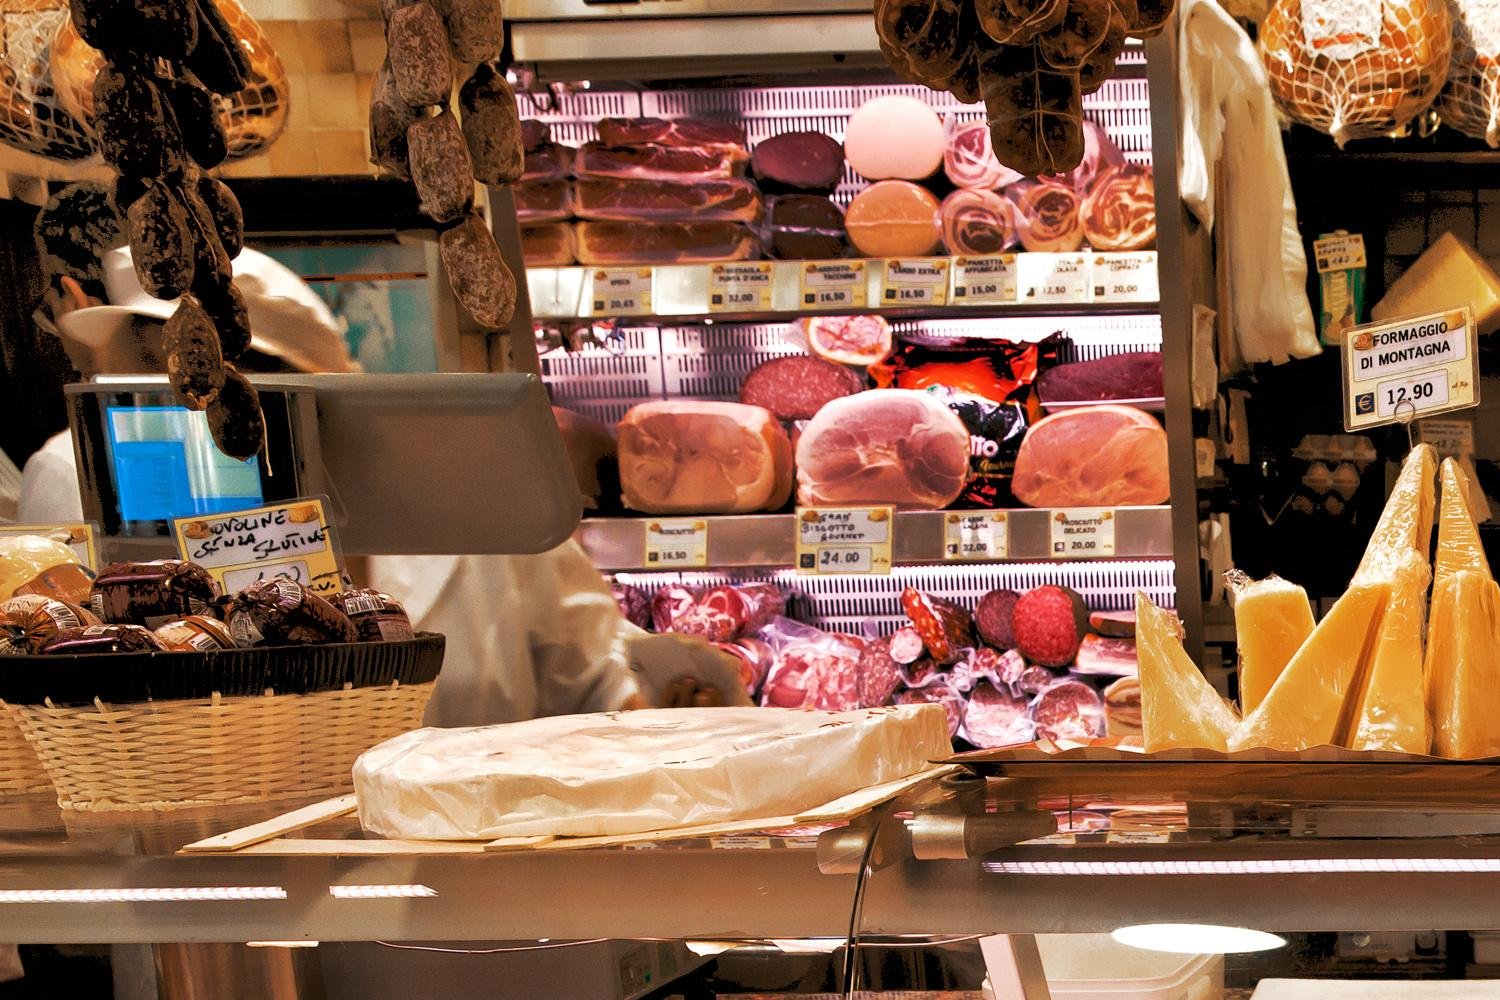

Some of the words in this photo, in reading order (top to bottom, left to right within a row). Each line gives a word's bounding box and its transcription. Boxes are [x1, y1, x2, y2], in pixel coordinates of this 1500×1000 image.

[1372, 321, 1448, 347] FORMAGGIO
[1361, 357, 1373, 370] DI
[1378, 340, 1451, 366] MONTAGNA
